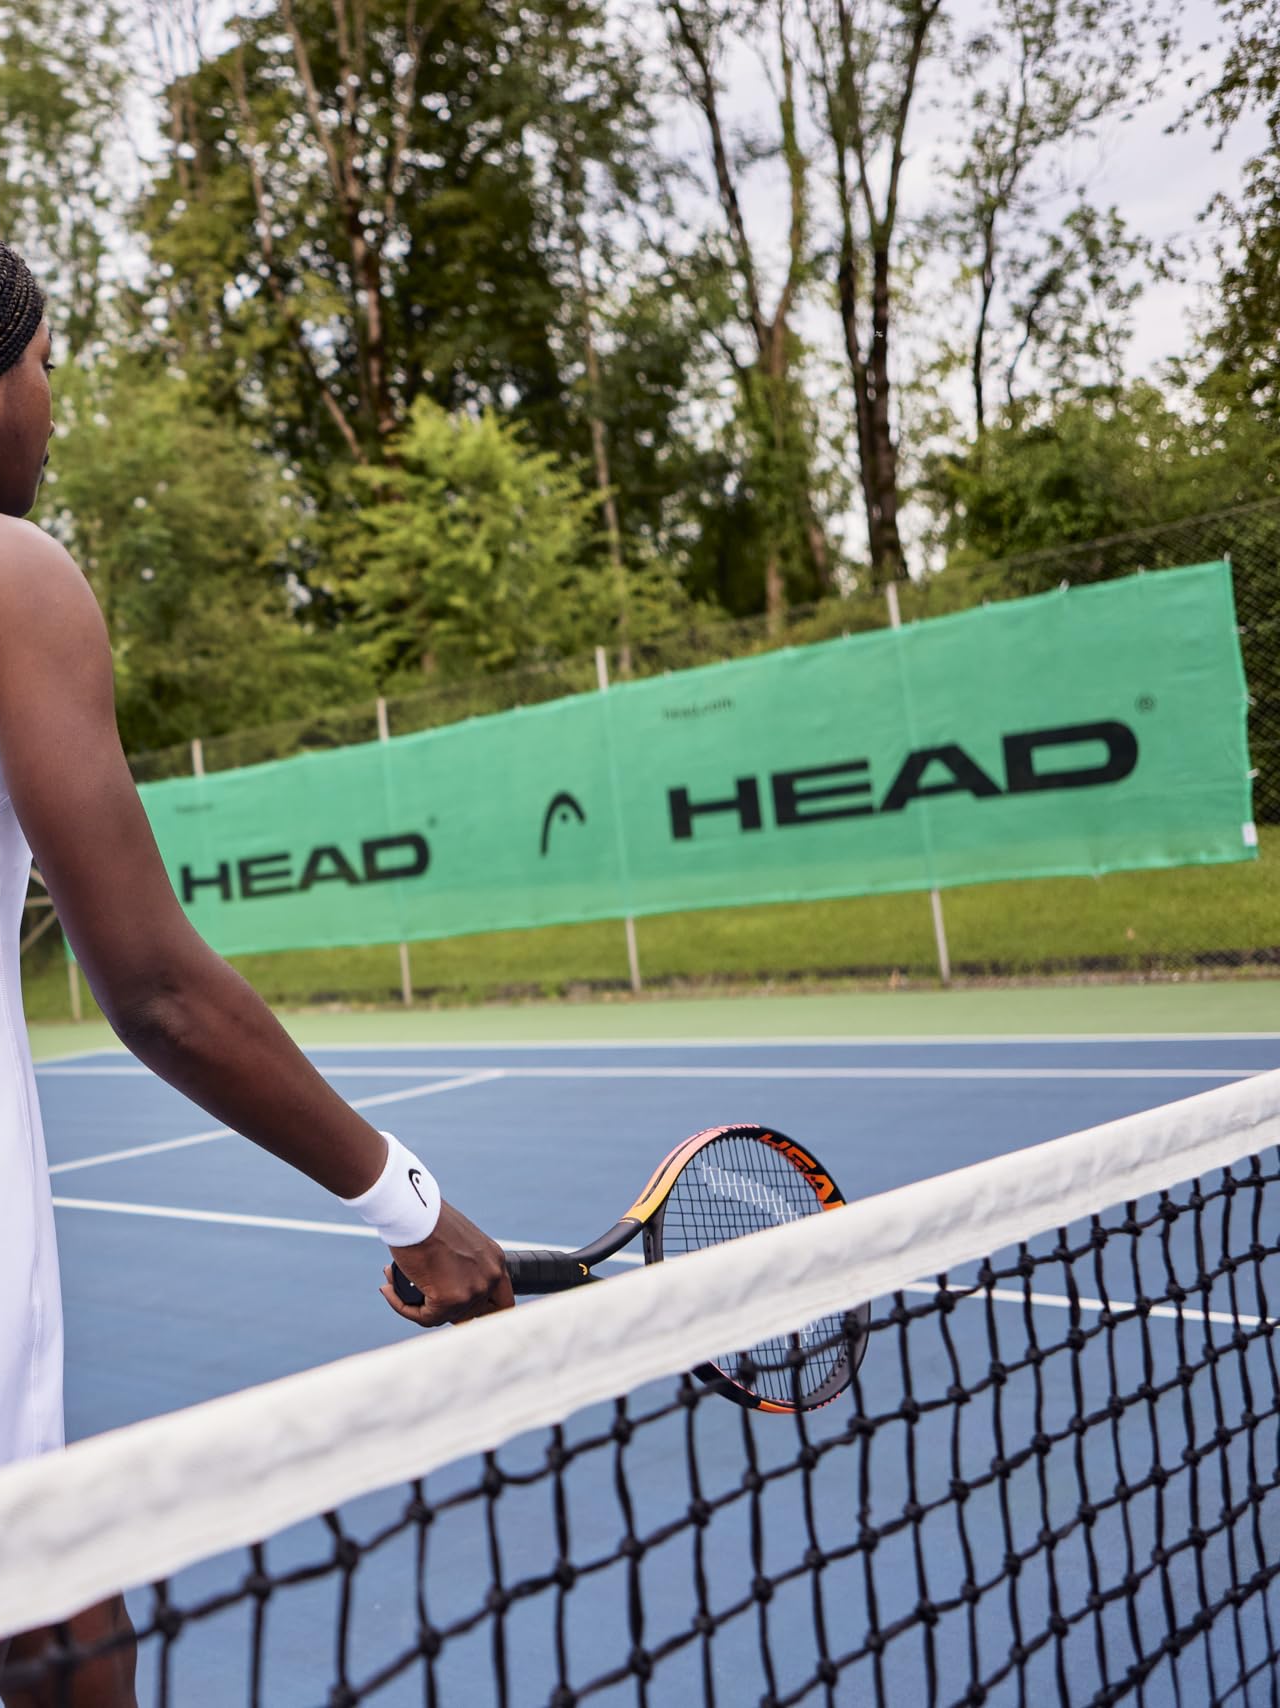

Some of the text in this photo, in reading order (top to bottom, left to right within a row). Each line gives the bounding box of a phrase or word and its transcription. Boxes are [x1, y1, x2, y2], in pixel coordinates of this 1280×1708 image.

[667, 720, 1139, 839] HEAD
[180, 833, 431, 904] HEAD
[758, 1132, 846, 1213] HEA
